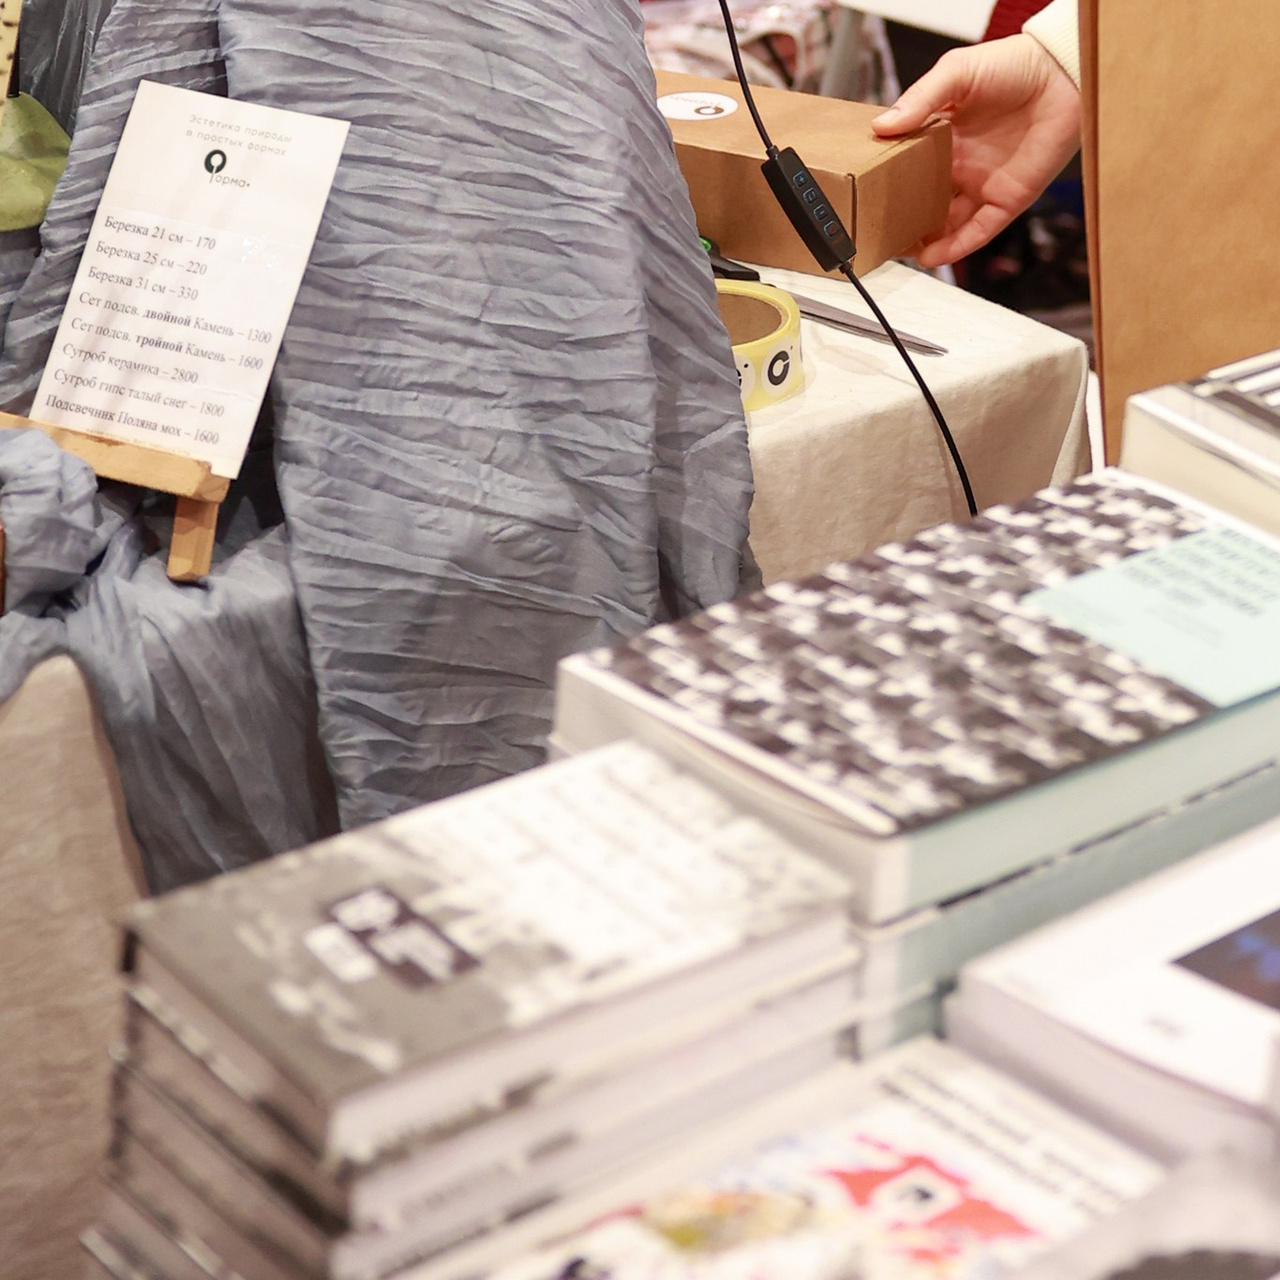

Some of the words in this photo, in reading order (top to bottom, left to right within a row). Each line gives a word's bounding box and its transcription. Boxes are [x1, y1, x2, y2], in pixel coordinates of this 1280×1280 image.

[189, 114, 240, 132] Эстетика
[244, 128, 292, 143] природы
[197, 132, 242, 147] простых
[248, 142, 286, 156] формах
[104, 216, 149, 236] Березка
[151, 226, 165, 240] 21
[168, 233, 184, 244] см
[196, 236, 216, 250] 170
[96, 241, 140, 261] Березка
[143, 251, 159, 265] 25
[160, 258, 175, 269] см
[186, 261, 207, 275] 220
[88, 266, 132, 287] Березка
[135, 276, 149, 290] 31
[152, 283, 166, 294] см
[177, 286, 199, 301] 330
[79, 292, 102, 307] Сет
[104, 301, 139, 316] подсв.
[142, 308, 191, 327] двойной
[193, 317, 234, 336] Камень
[247, 329, 272, 344] 1300
[71, 317, 93, 333] Сет
[95, 325, 131, 342] подсв.
[135, 335, 183, 353] тройной
[185, 343, 226, 362] Камень
[239, 355, 263, 370] 1600
[63, 343, 106, 362] Сугроб
[108, 356, 160, 377] керамика
[171, 367, 199, 384] 2800
[54, 368, 97, 389] Сугроб
[99, 380, 125, 397] гипс
[128, 388, 161, 404] талый
[163, 396, 187, 410] снег
[200, 401, 225, 418] 1800
[45, 394, 115, 422] Подсвечник
[117, 411, 158, 432] Поляна
[160, 424, 181, 437] мох
[194, 428, 220, 445] 1600
